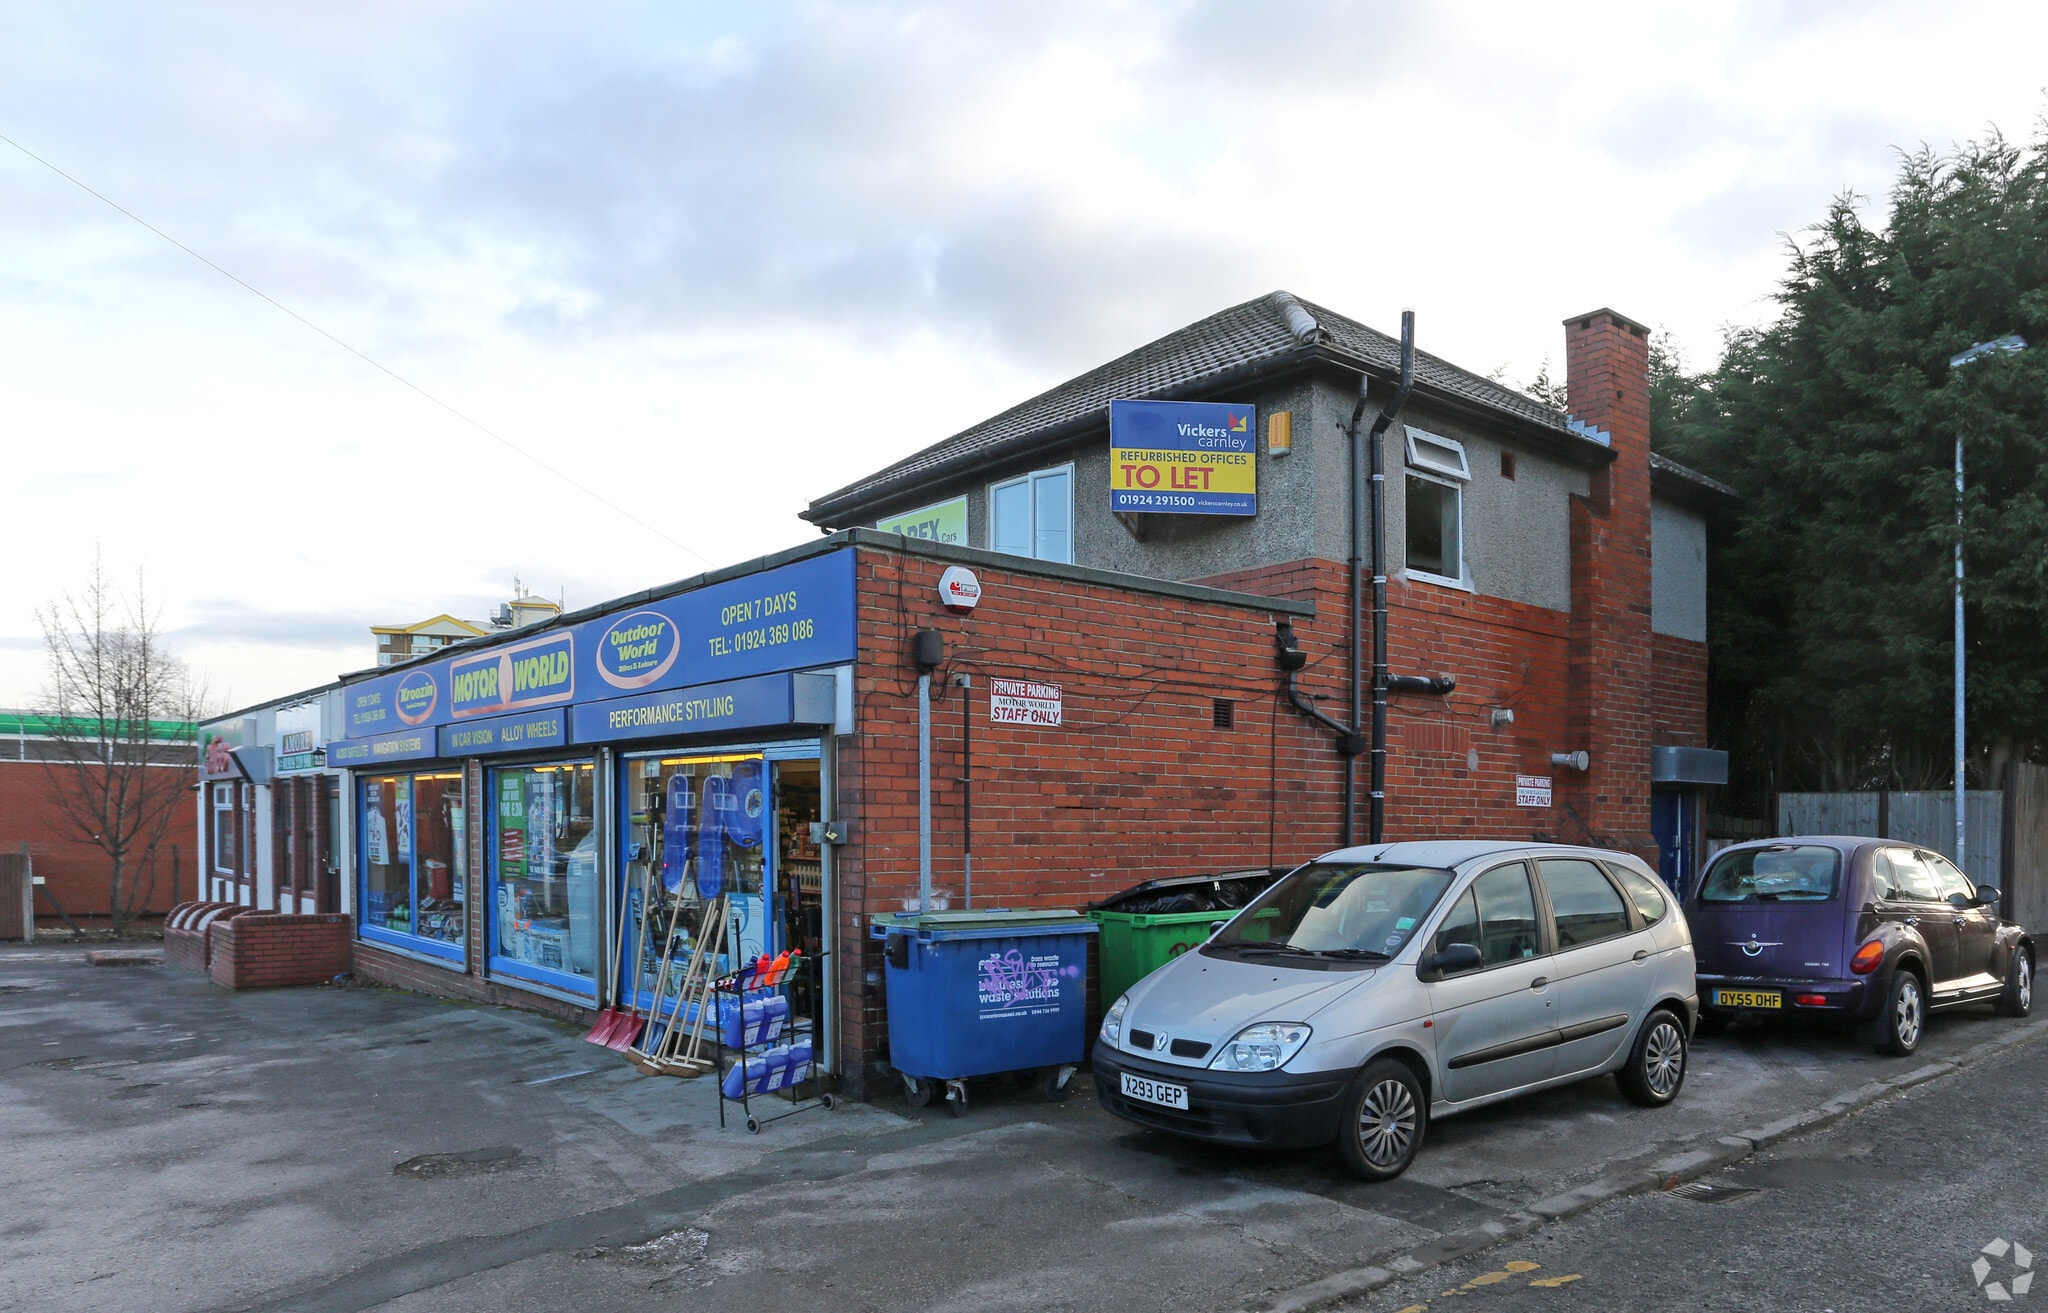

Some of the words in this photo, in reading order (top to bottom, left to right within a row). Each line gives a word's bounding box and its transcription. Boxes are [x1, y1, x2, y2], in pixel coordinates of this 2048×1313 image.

[1177, 424, 1227, 437] Vickers
[1198, 434, 1247, 452] carnley
[1120, 451, 1196, 463] REFURBISHED
[1200, 453, 1247, 465] OFFICES
[1120, 464, 1160, 489] TO
[1171, 466, 1214, 490] LET
[1119, 494, 1152, 505] 01924
[1155, 495, 1195, 507] 291500
[1198, 500, 1248, 508] vickerscarnley.co.uk
[941, 532, 957, 543] Cars
[721, 601, 752, 626] OPEN
[755, 599, 761, 619] 7
[764, 590, 797, 617] DAYS
[610, 622, 665, 646] Outdoor
[709, 636, 732, 657] TEL:
[734, 627, 766, 652] 01924
[768, 623, 788, 646] 369
[792, 618, 813, 642] 086
[617, 638, 658, 661] World
[454, 667, 498, 704] MOTOR
[514, 650, 569, 692] WORLD
[400, 682, 434, 703] Kroozin
[993, 681, 1025, 696] PRIVATE
[1027, 683, 1059, 700] PARKING
[609, 702, 683, 729] PERFORMANCE
[686, 695, 734, 720] STYLING
[998, 698, 1026, 707] MOTOR
[1027, 700, 1055, 710] WORLD
[993, 706, 1028, 721] STAFF
[1031, 709, 1060, 724] ONLY
[284, 733, 309, 753] AMORE
[459, 732, 472, 747] CAR
[473, 729, 493, 745] VISION
[501, 725, 524, 742] ALLOY
[526, 720, 557, 739] WHEELS
[1518, 795, 1535, 805] STAFF
[1536, 796, 1550, 806] ONLY
[979, 991, 1012, 1004] waste
[1014, 988, 1060, 1001] slutions
[1720, 993, 1752, 1006] OY55
[1755, 994, 1780, 1007] OHF
[1125, 1076, 1153, 1099] X293
[1156, 1085, 1182, 1104] GEP
